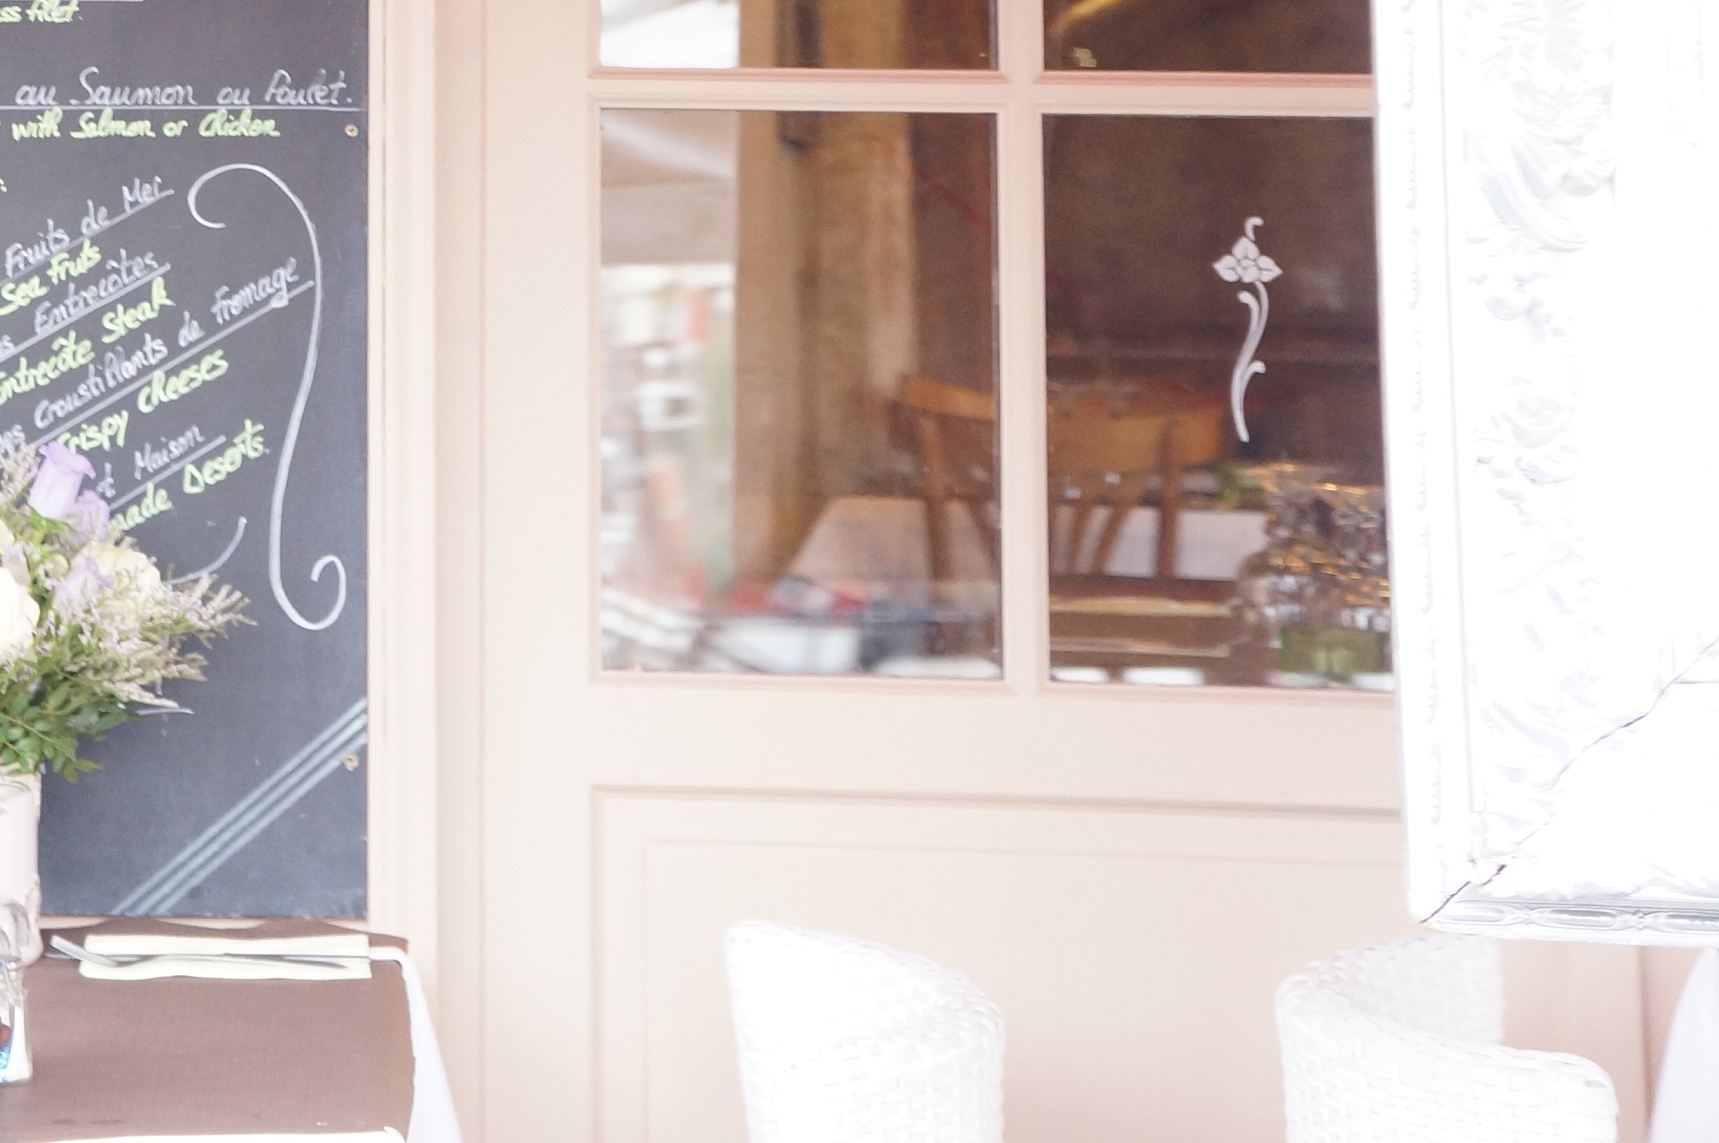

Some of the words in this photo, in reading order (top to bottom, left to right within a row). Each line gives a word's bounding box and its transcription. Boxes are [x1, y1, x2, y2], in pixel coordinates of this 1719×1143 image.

[15, 84, 59, 106] au
[70, 66, 196, 106] Saumon
[70, 107, 156, 139] Salmon
[162, 118, 189, 137] or
[198, 107, 280, 139] Chicken
[5, 218, 70, 276] Fruits
[81, 199, 111, 235] de
[178, 310, 205, 348] de
